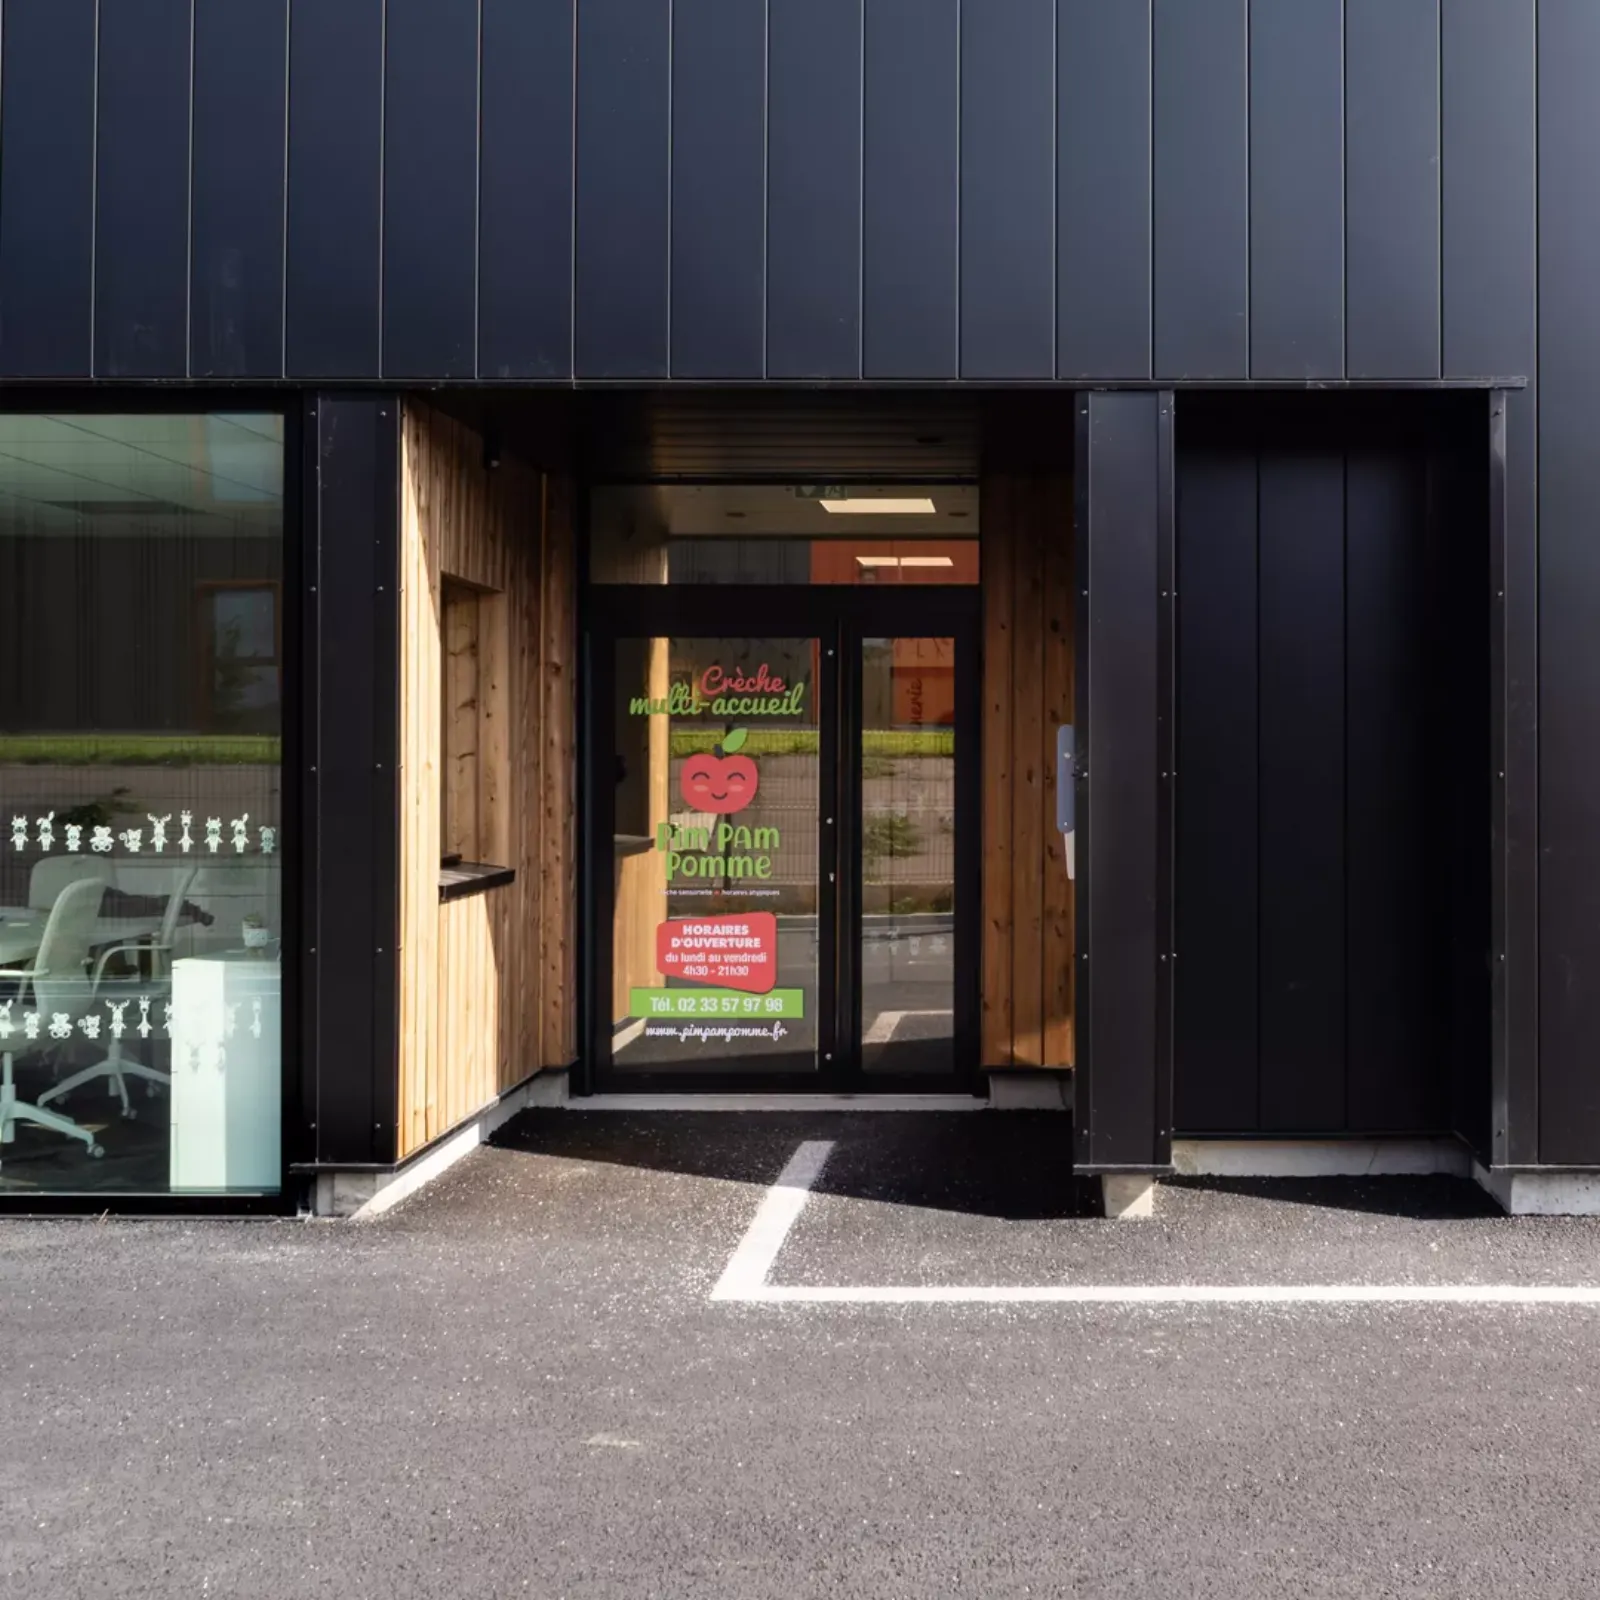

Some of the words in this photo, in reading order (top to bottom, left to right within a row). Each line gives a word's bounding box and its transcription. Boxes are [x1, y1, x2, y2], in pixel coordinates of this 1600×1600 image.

[701, 664, 786, 695] Crèche
[629, 682, 804, 715] multi-accueil
[666, 852, 772, 880] Pomme
[683, 924, 749, 936] HORAIRES
[671, 937, 761, 948] D'OUVERTURE
[665, 952, 678, 963] du
[681, 952, 706, 963] lundi
[708, 954, 721, 963] au
[724, 952, 767, 963] vendredi
[683, 965, 708, 976] 4h30
[718, 965, 749, 976] 21h30
[650, 996, 675, 1013] Tél.
[678, 997, 696, 1013] 02
[700, 997, 718, 1013] 33
[722, 997, 740, 1013] 57
[743, 997, 761, 1013] 97
[765, 997, 783, 1013] 98
[645, 1020, 788, 1043] www.pimpampomme.fr
